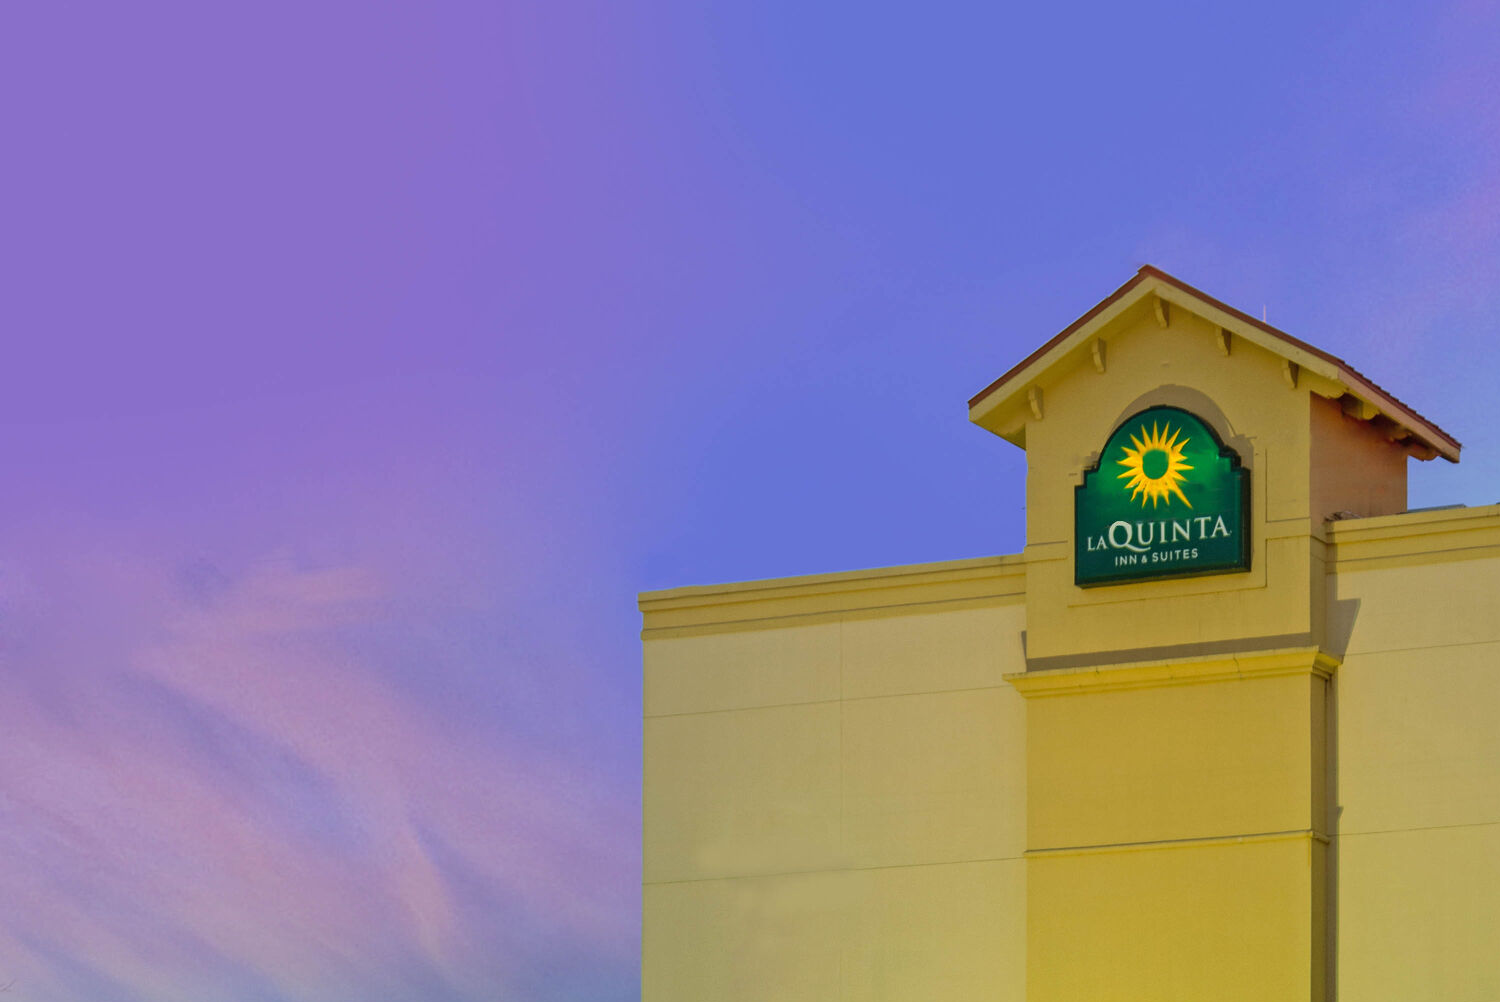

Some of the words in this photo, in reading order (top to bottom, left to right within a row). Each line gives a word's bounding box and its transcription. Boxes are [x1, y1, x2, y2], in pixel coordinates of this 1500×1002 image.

[1115, 554, 1138, 567] INN
[1141, 556, 1148, 564] &
[1152, 548, 1199, 563] SUITES
